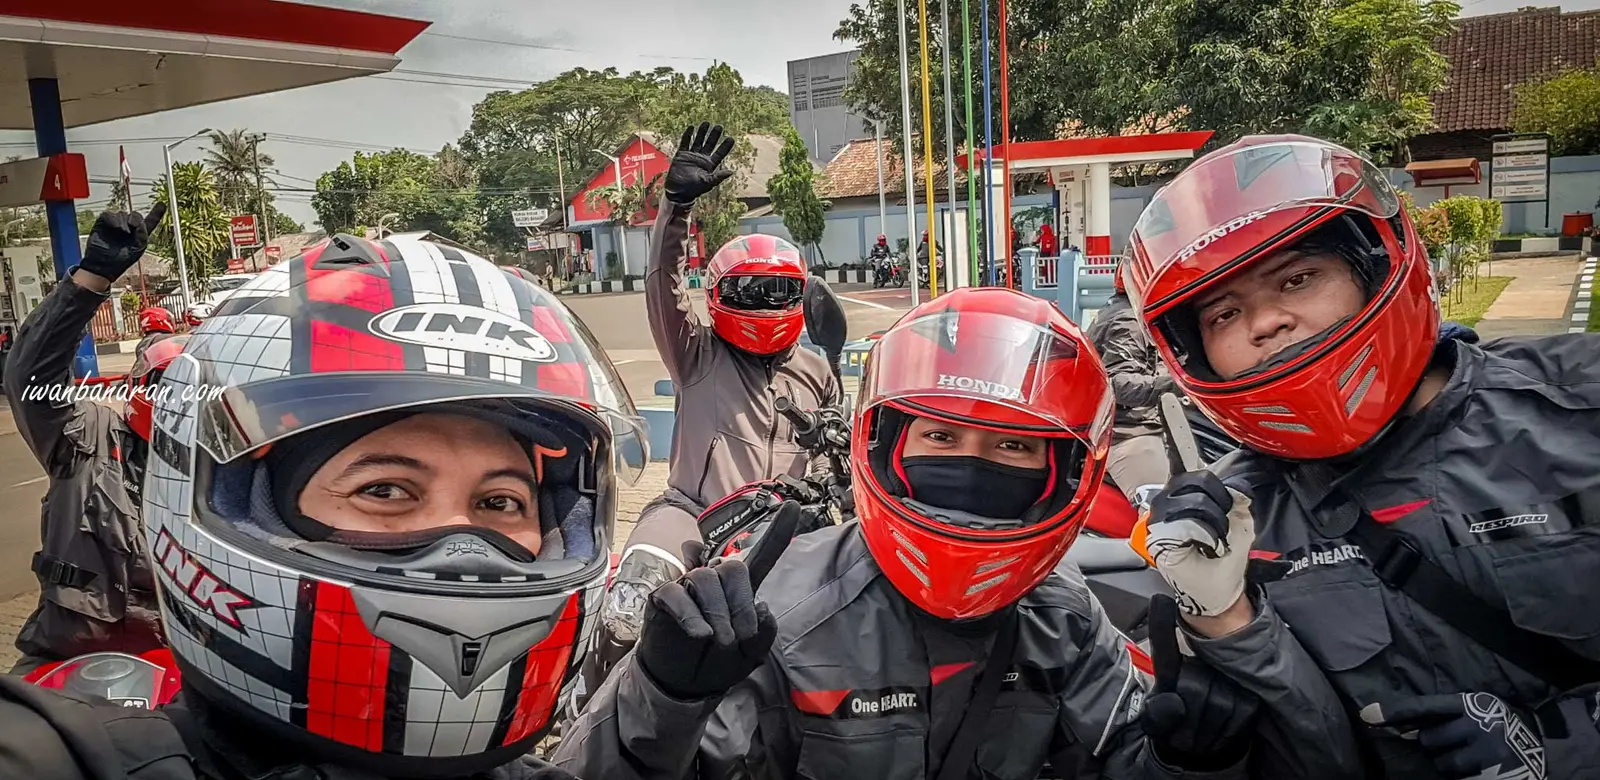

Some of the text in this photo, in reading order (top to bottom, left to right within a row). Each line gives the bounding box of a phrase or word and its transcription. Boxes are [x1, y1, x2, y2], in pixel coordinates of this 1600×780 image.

[54, 174, 60, 190] 4
[1179, 210, 1267, 263] HONDA
[392, 311, 542, 353] INK
[937, 374, 1027, 403] HONDA
[708, 517, 734, 540] KUCAY
[1469, 514, 1548, 533] RESPIRO
[1311, 544, 1364, 565] HEART.
[154, 529, 250, 632] INK
[851, 692, 917, 713] One HEART.
